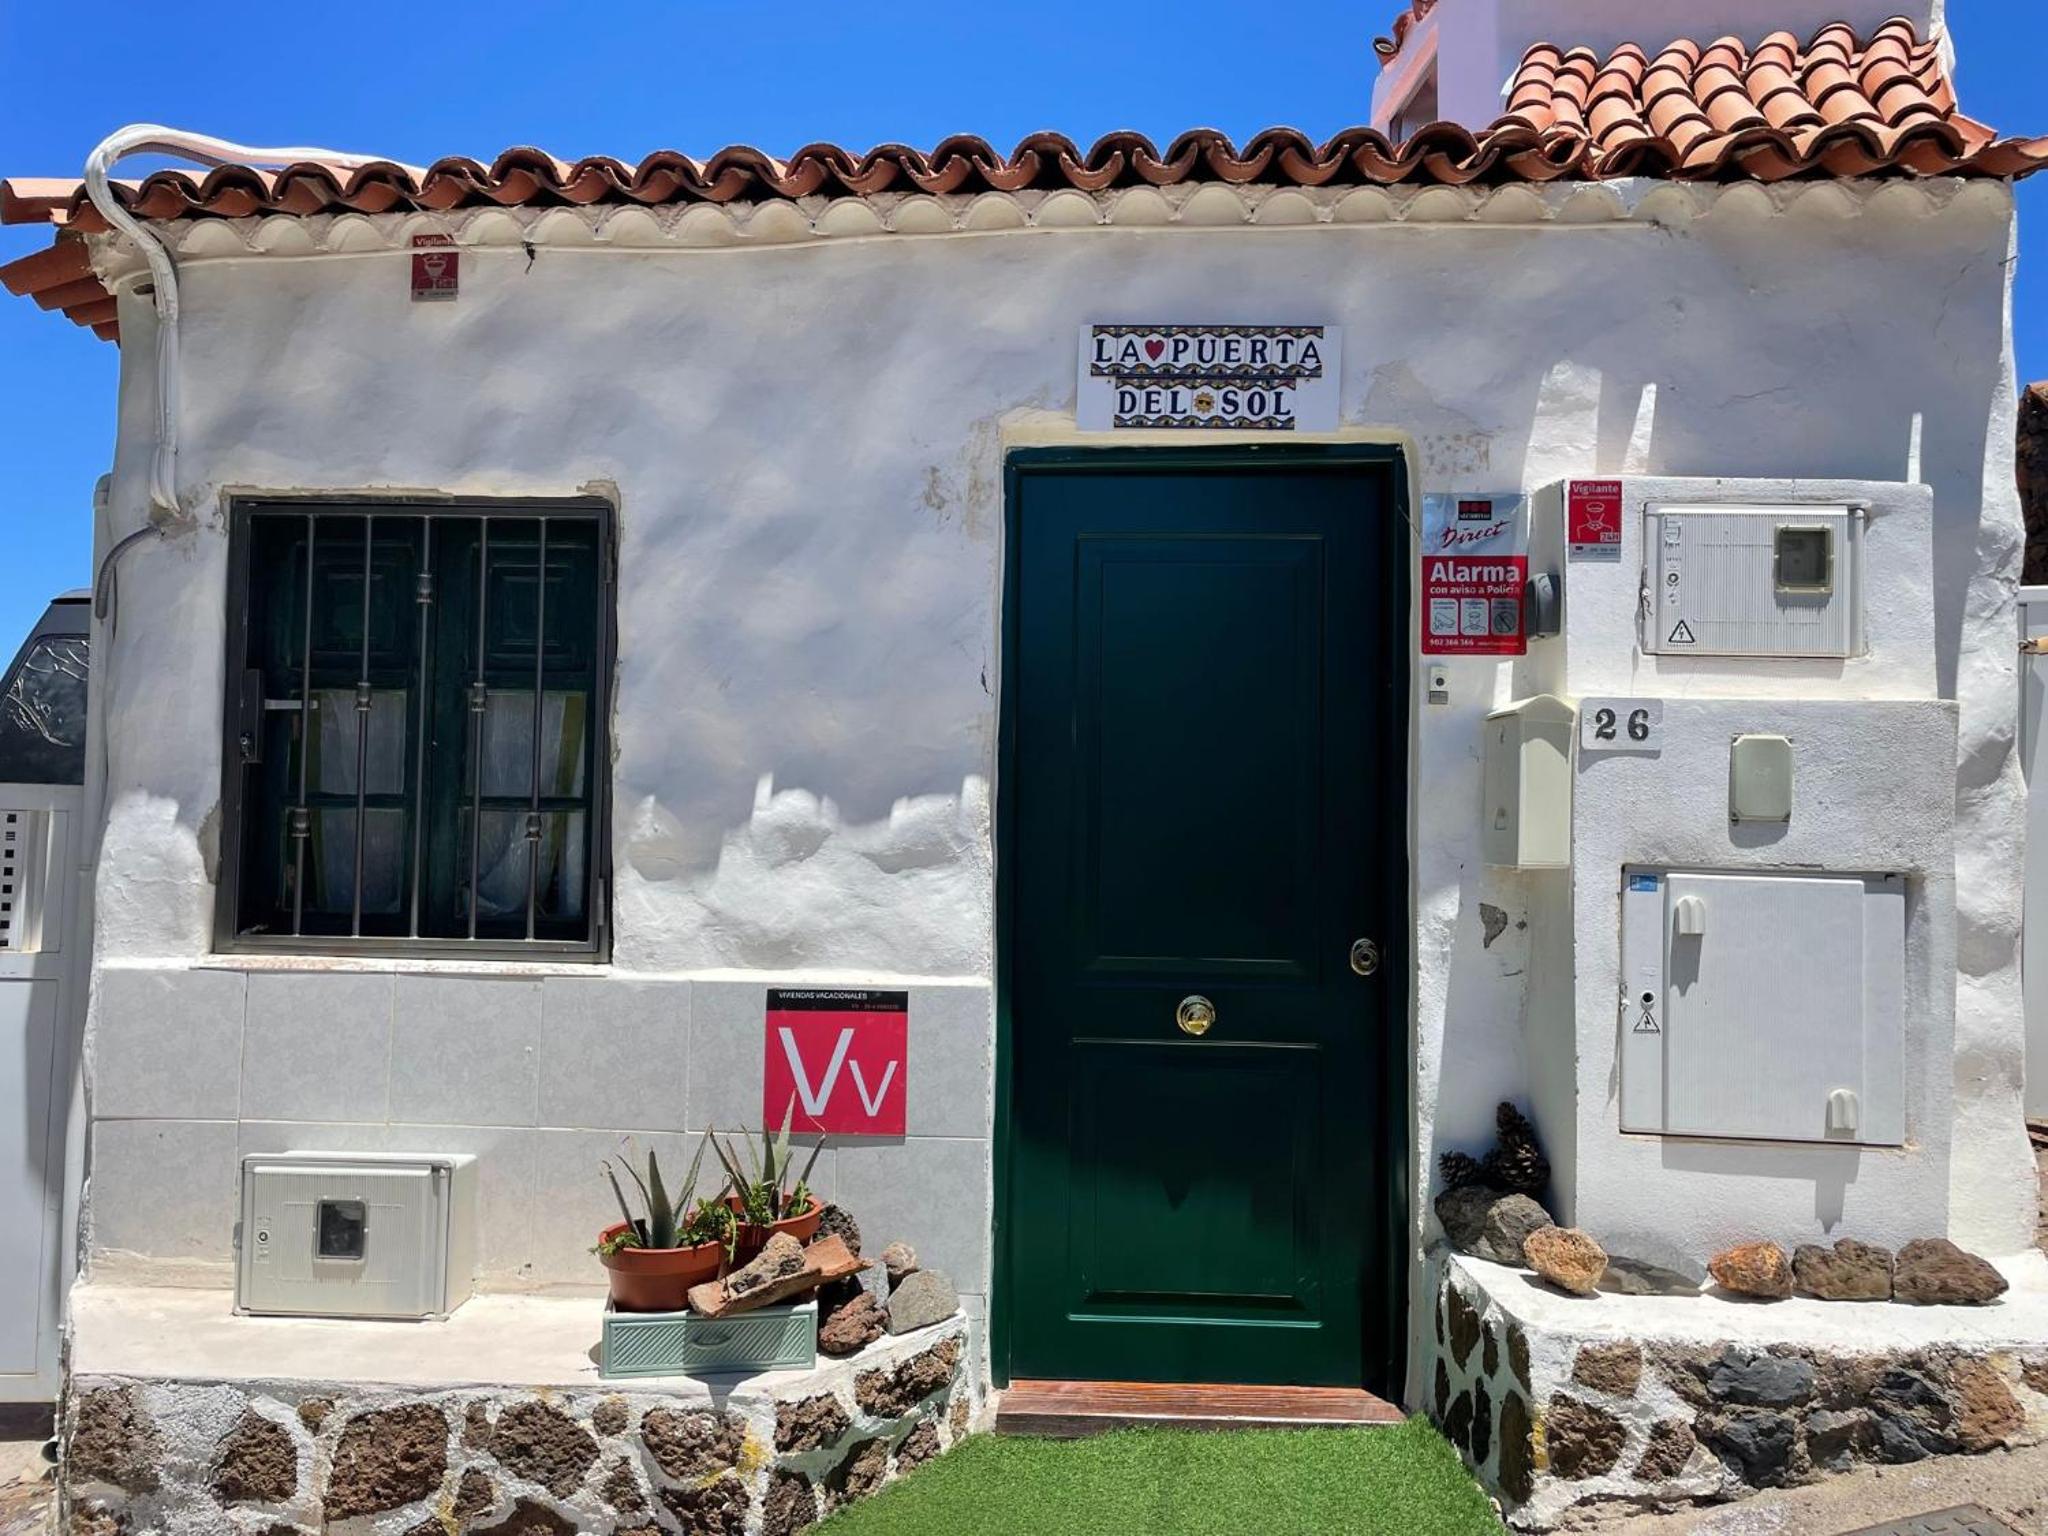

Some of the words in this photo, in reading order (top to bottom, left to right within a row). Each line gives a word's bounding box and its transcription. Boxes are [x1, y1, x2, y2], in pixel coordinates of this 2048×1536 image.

[1094, 338, 1141, 363] LA
[1171, 339, 1322, 364] PUERTA
[1118, 390, 1188, 415] DEL
[1221, 390, 1292, 416] SOL
[1572, 482, 1620, 495] Vigilante
[1440, 519, 1513, 549] Direct
[1430, 560, 1520, 583] Alarma
[1430, 586, 1448, 594] con
[1449, 584, 1477, 594] aviso
[1478, 586, 1485, 594] a
[1595, 707, 1649, 742] 26
[779, 991, 815, 999] VIVIENDAS
[816, 992, 868, 1001] VACACIONALES
